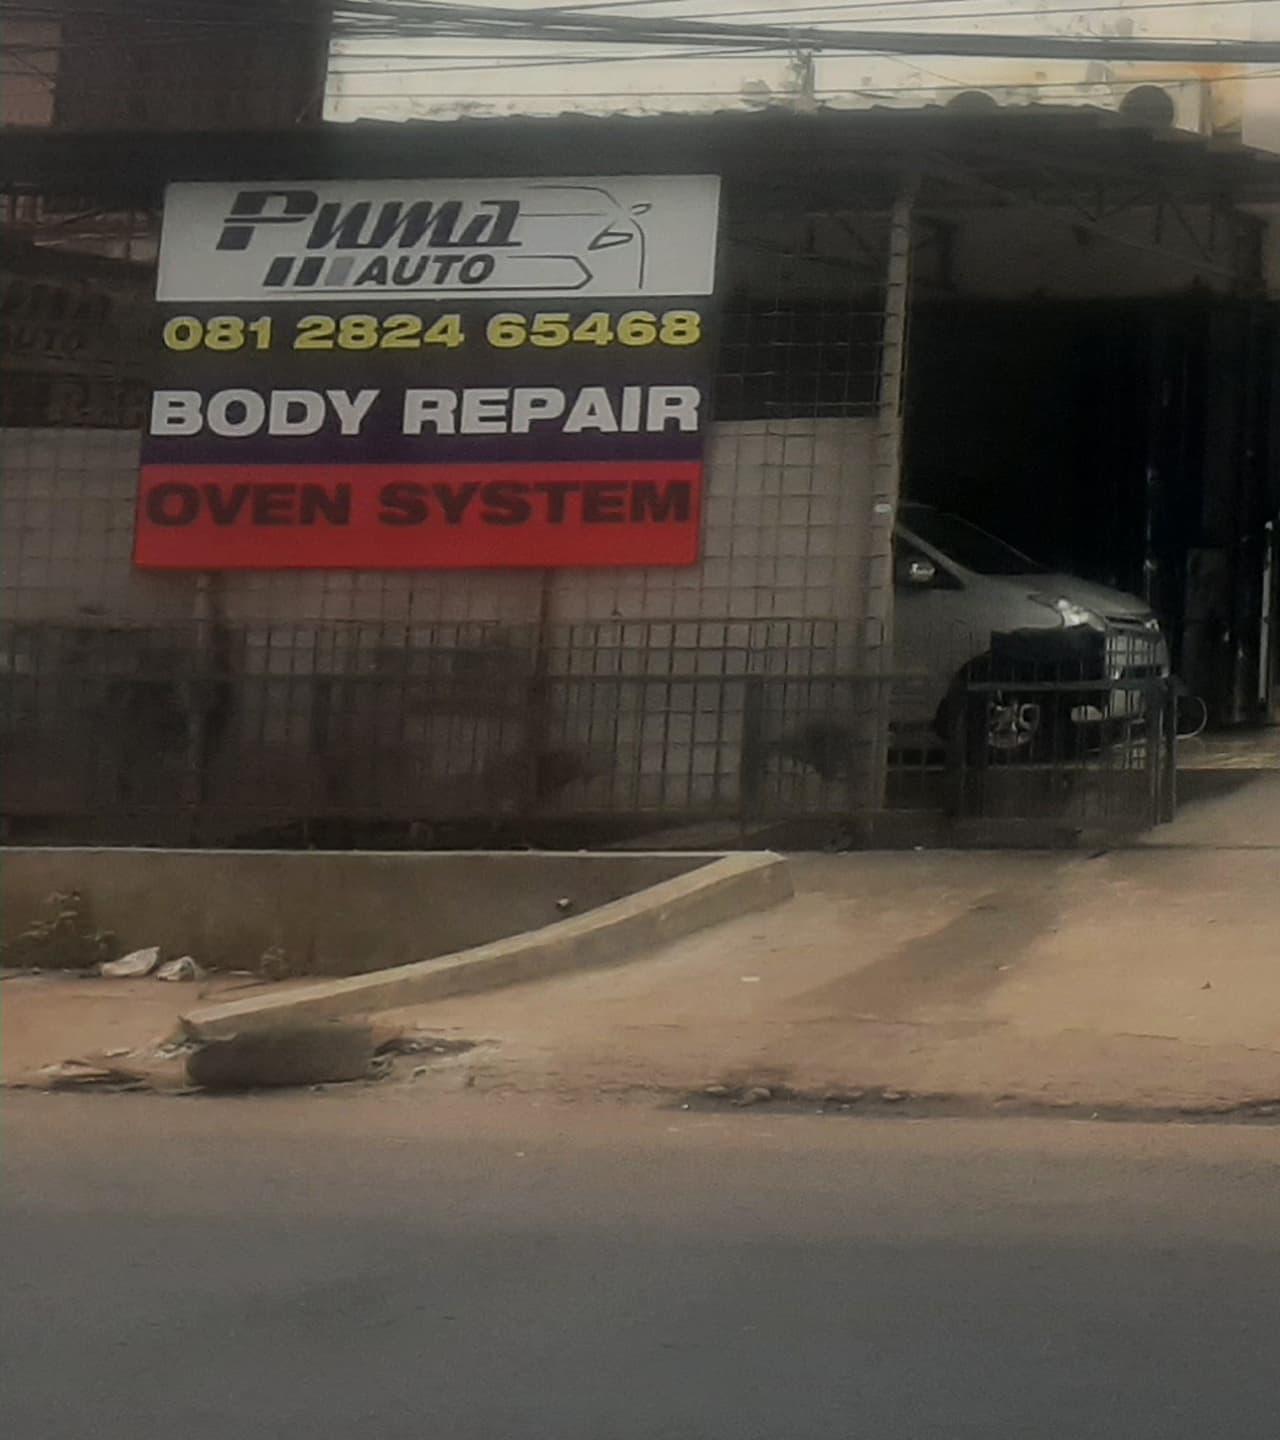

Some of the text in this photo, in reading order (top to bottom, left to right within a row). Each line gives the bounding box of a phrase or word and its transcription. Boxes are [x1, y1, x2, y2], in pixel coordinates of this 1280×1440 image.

[355, 255, 495, 286] AUTO
[164, 311, 701, 350] 081 2824 65468
[150, 385, 700, 436] BODY REPAIR
[146, 480, 691, 527] OVEN SYSTEM
